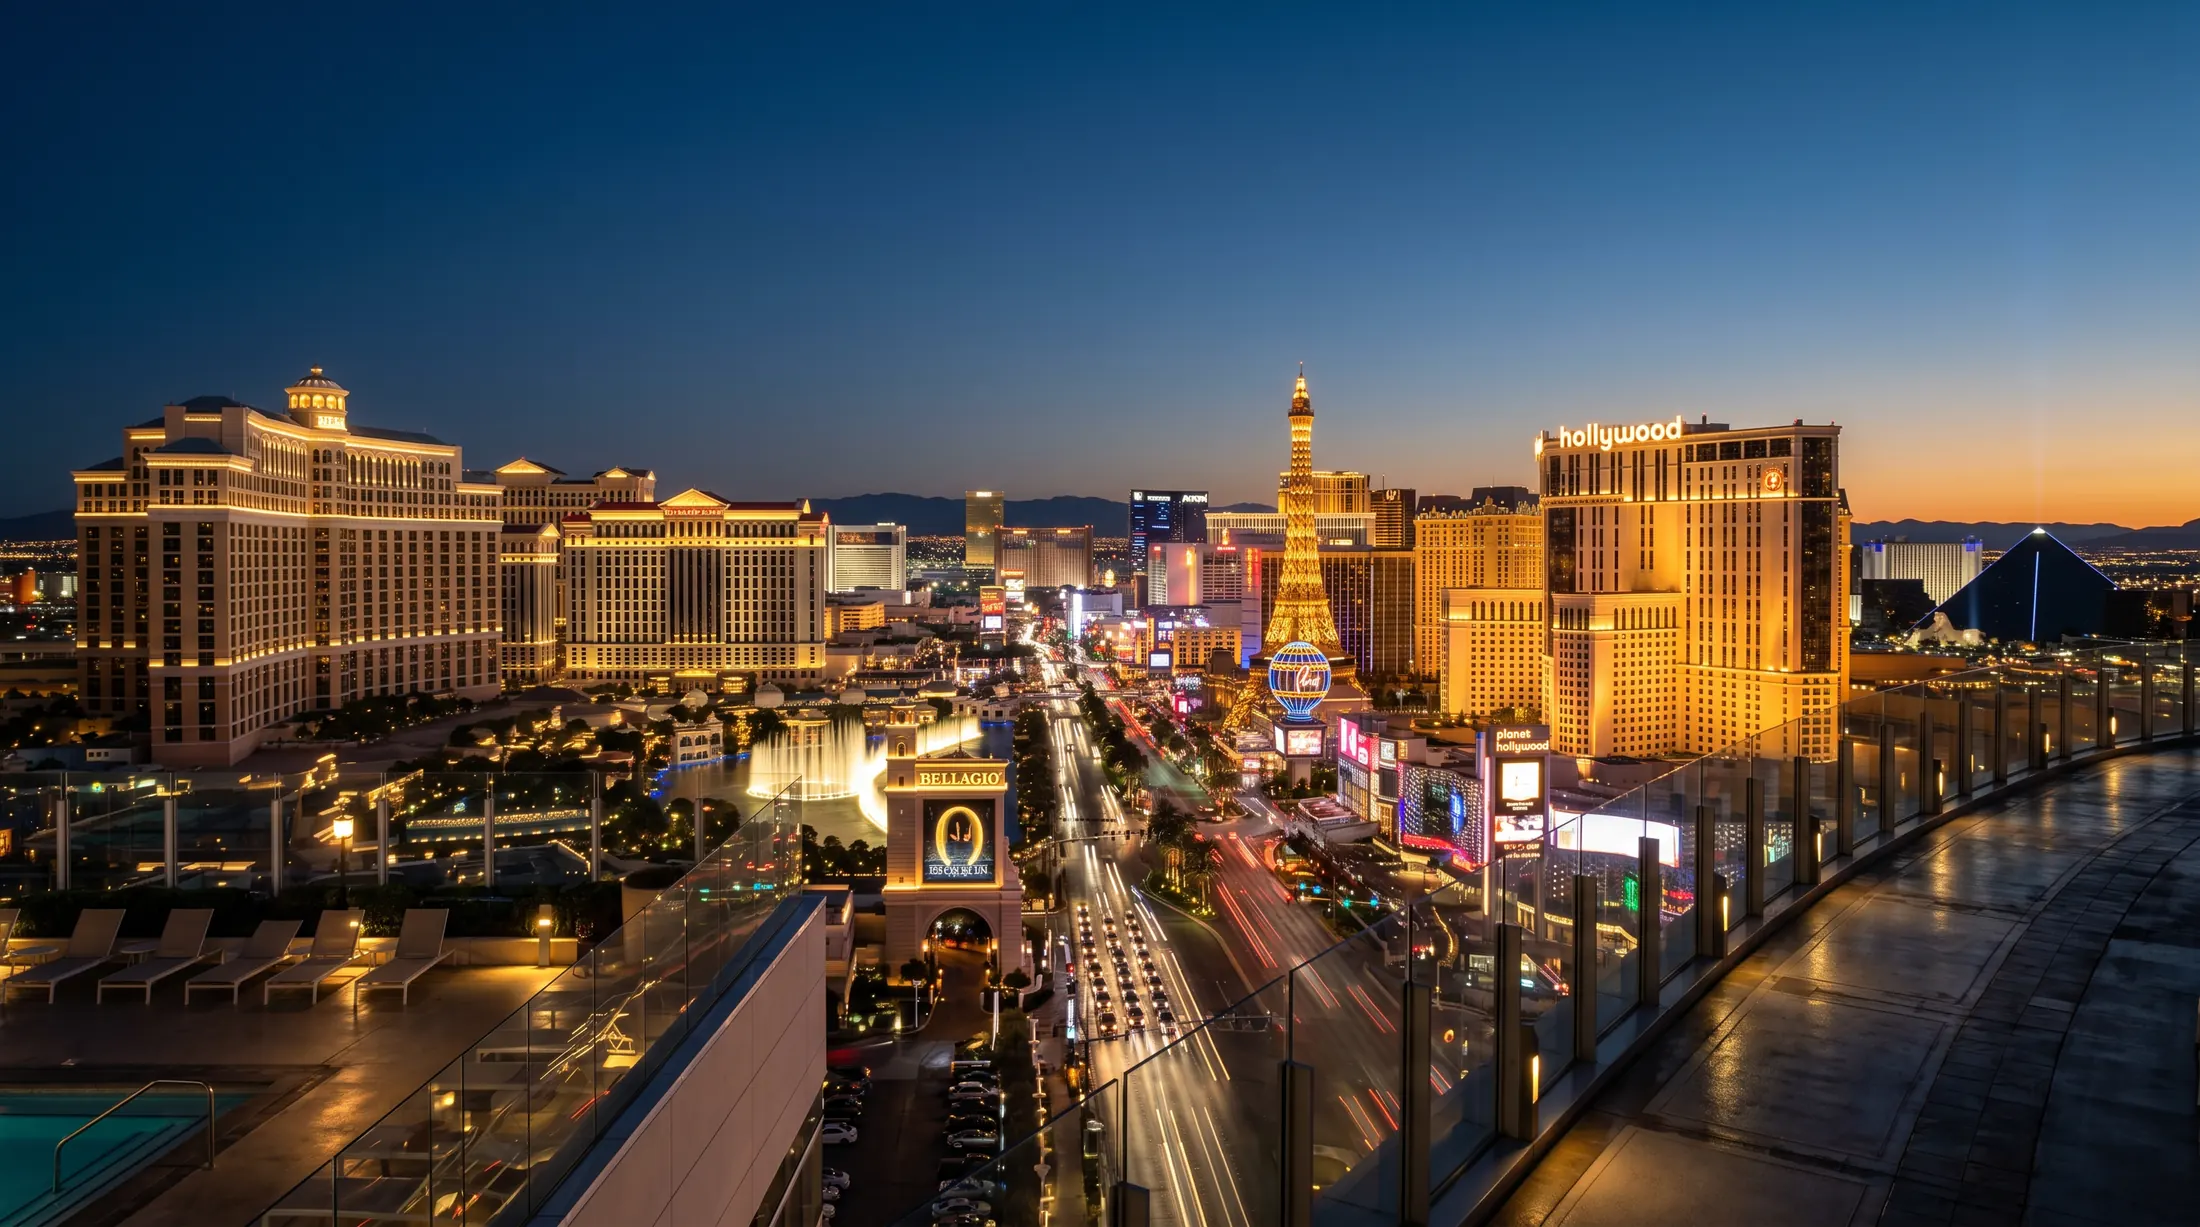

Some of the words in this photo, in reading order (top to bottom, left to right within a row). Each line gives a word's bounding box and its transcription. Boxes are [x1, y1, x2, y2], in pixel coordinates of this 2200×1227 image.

[1559, 414, 1682, 452] hollywood
[1496, 728, 1531, 741] planet
[1496, 740, 1549, 754] hollywood
[919, 772, 1000, 785] BELLAGIO
